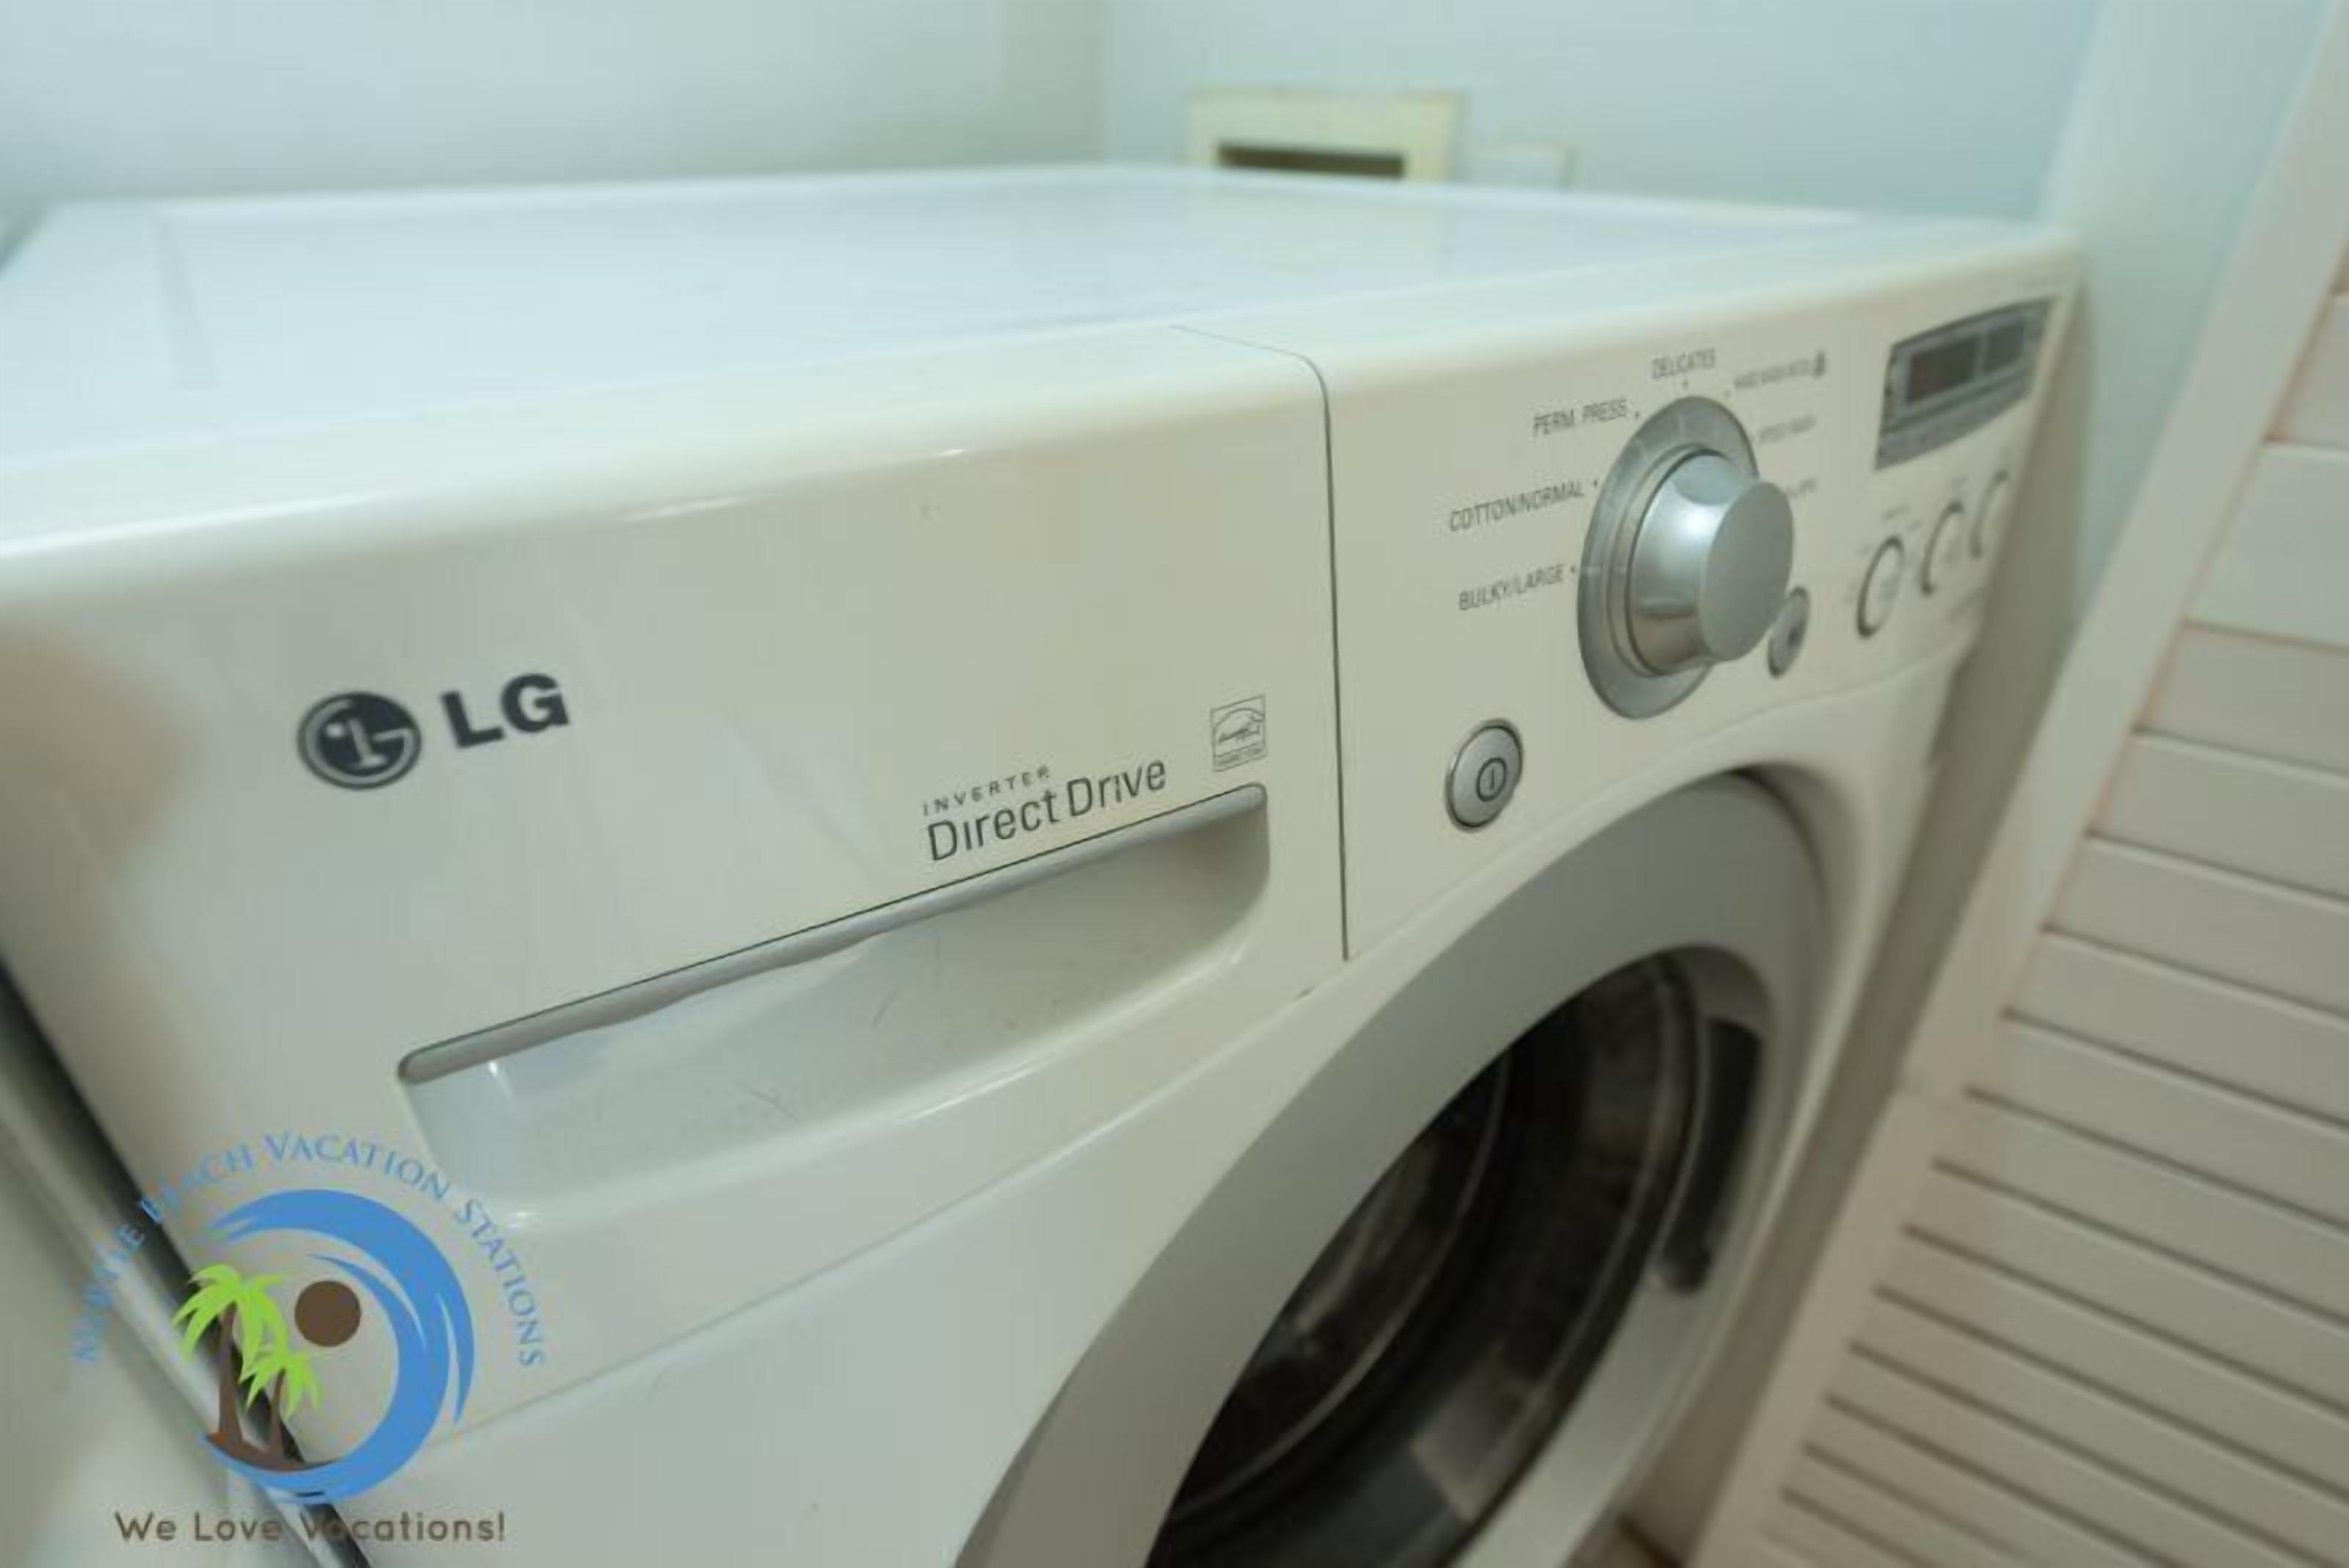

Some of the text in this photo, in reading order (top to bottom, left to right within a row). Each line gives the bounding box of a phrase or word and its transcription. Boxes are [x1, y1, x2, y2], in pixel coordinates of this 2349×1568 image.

[1652, 348, 1716, 380] DELICATES
[1583, 398, 1628, 424] PRESS
[1449, 480, 1586, 533] COTTON/NORMAL
[1459, 562, 1566, 611] BULKY/LARGE
[440, 672, 570, 749] LG
[922, 764, 1050, 816] INVERTER
[927, 759, 1167, 862] Direct Drive
